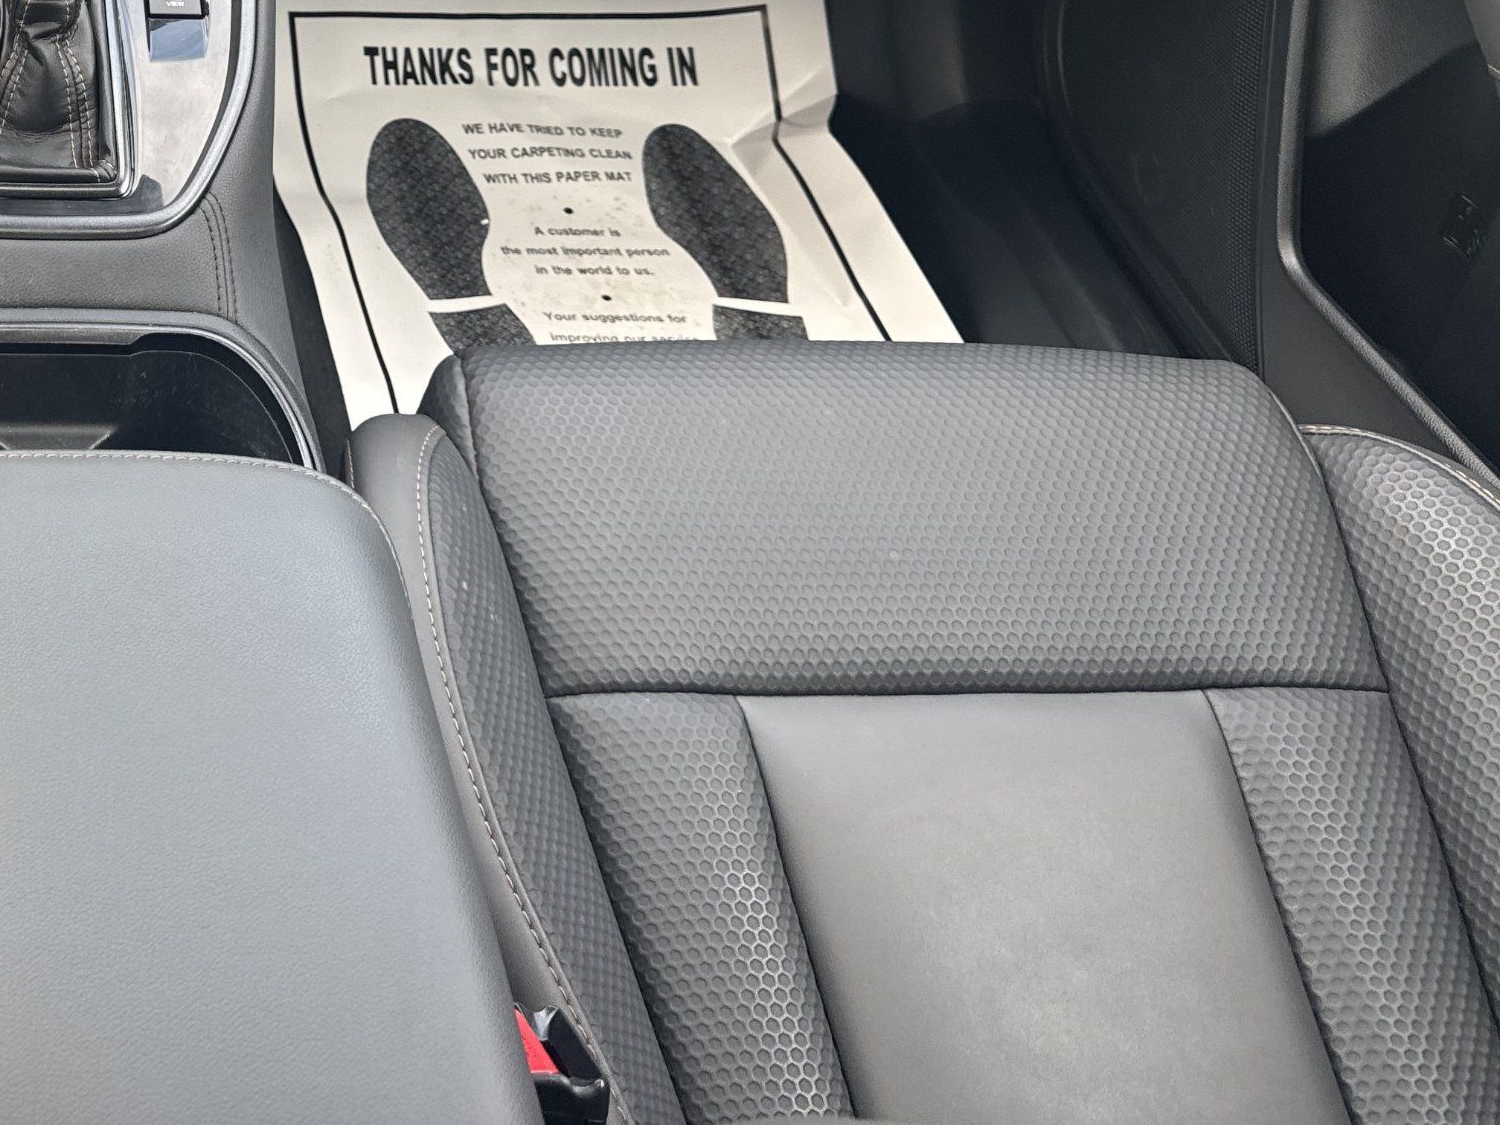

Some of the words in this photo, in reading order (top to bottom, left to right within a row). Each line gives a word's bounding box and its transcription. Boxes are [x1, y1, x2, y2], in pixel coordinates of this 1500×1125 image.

[363, 46, 474, 86] THANKS
[484, 47, 540, 87] FOR
[548, 47, 659, 87] COMING
[667, 46, 699, 87] IN
[462, 123, 484, 135] WE
[488, 122, 525, 134] HAVE
[529, 125, 564, 136] TRIED
[568, 126, 587, 137] TO
[591, 127, 623, 139] KEEP
[468, 148, 506, 160] YOUR
[511, 146, 586, 159] CARPETING
[589, 148, 634, 160] CLEAN
[483, 172, 518, 185] WITH
[522, 171, 551, 184] THIS
[556, 170, 601, 183] PAPER
[605, 170, 633, 182] MAT
[534, 227, 545, 236] A
[548, 227, 605, 237] customer
[609, 226, 621, 237] is
[500, 246, 523, 256] the
[526, 246, 560, 256] most
[563, 246, 622, 259] important
[625, 247, 671, 259] person
[552, 265, 572, 275] the
[578, 265, 613, 276] world
[616, 266, 630, 276] to
[634, 268, 655, 276] us.
[543, 311, 577, 321] Your
[582, 312, 665, 324] suggestions
[667, 313, 687, 323] for
